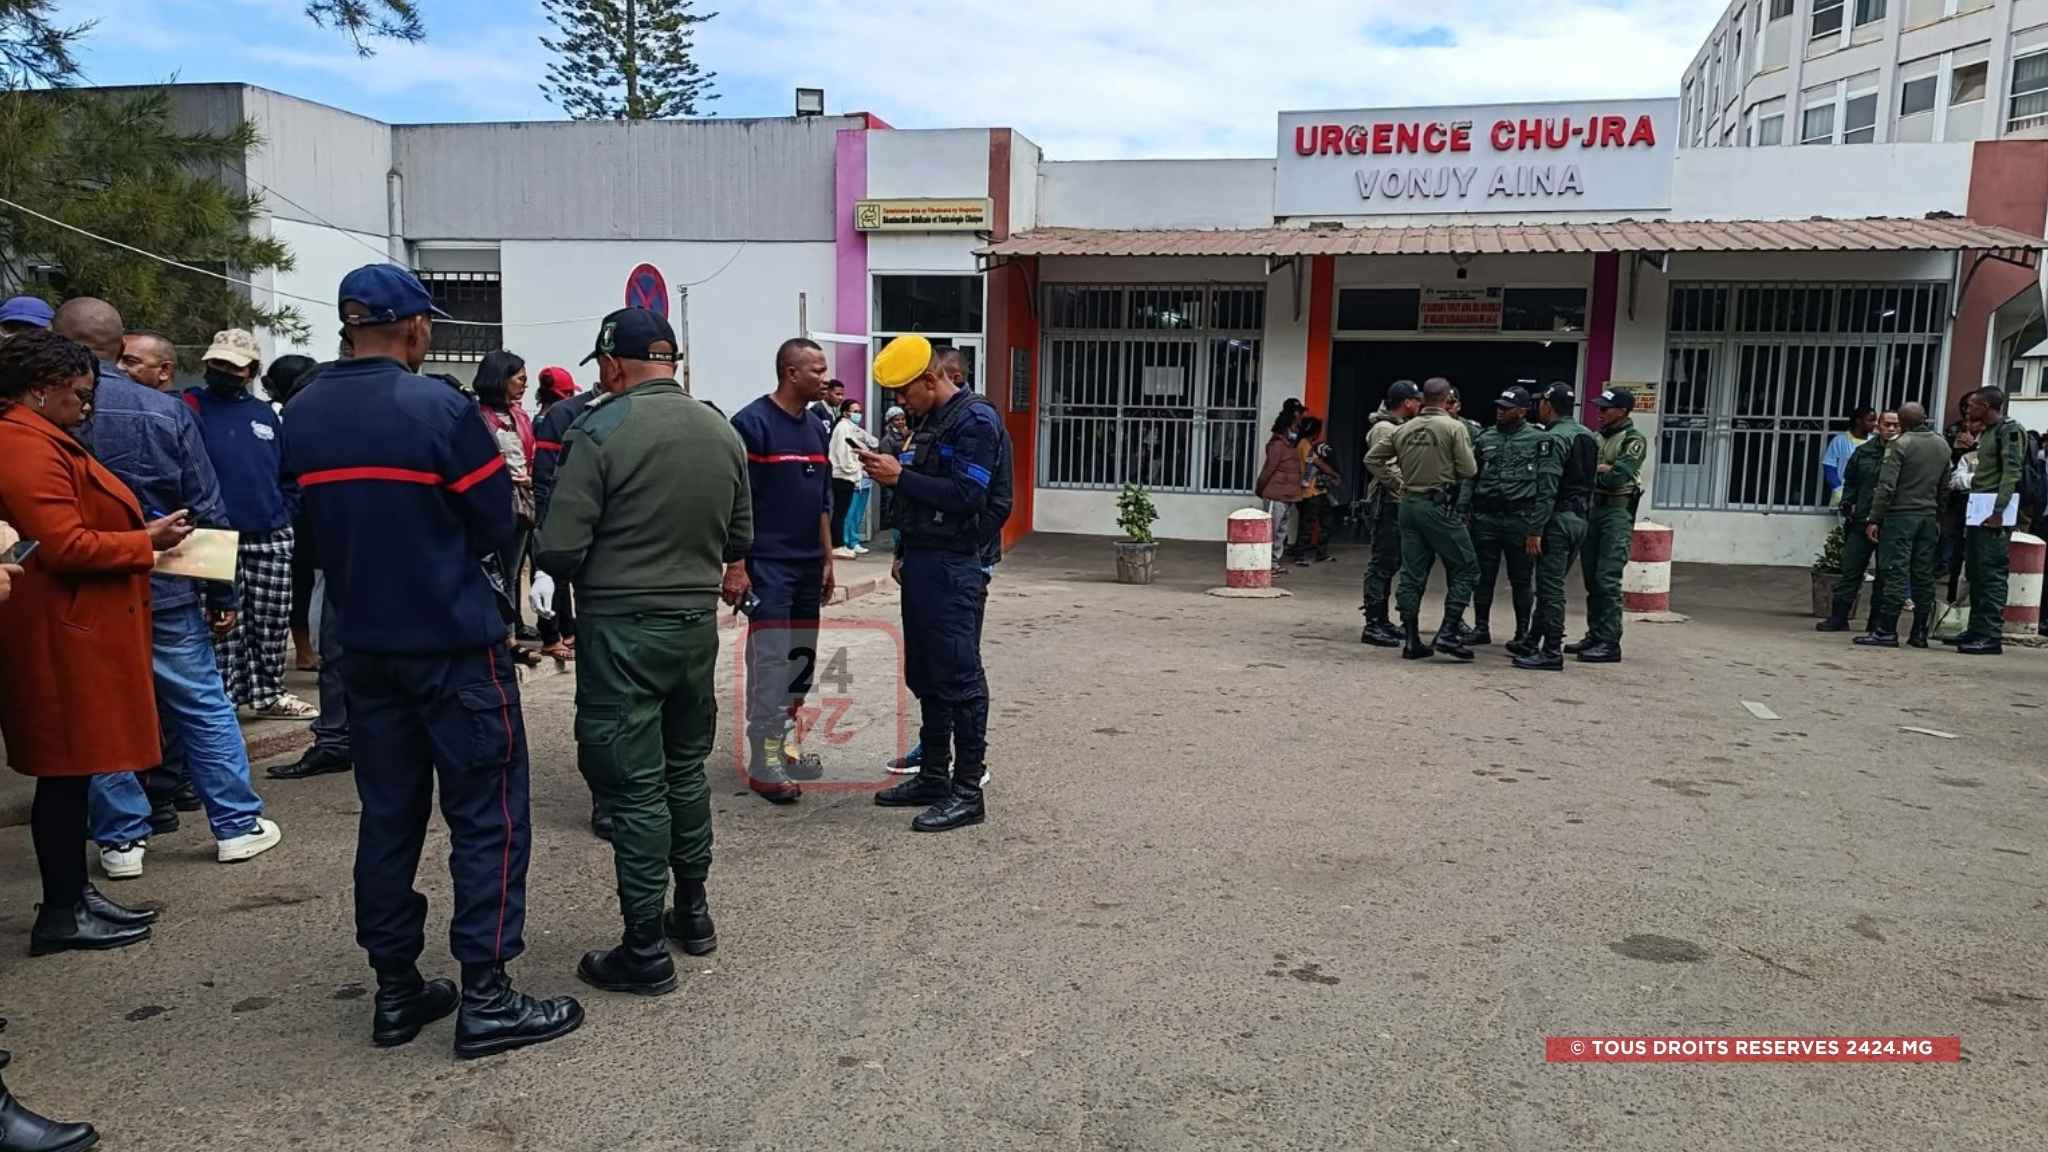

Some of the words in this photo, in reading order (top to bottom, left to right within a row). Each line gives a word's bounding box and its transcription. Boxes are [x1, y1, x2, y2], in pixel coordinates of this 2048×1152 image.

[1295, 121, 1473, 157] URGENCE
[1490, 115, 1656, 151] CHU-JRA
[1355, 165, 1478, 200] VONJY
[1487, 163, 1585, 197] AINA
